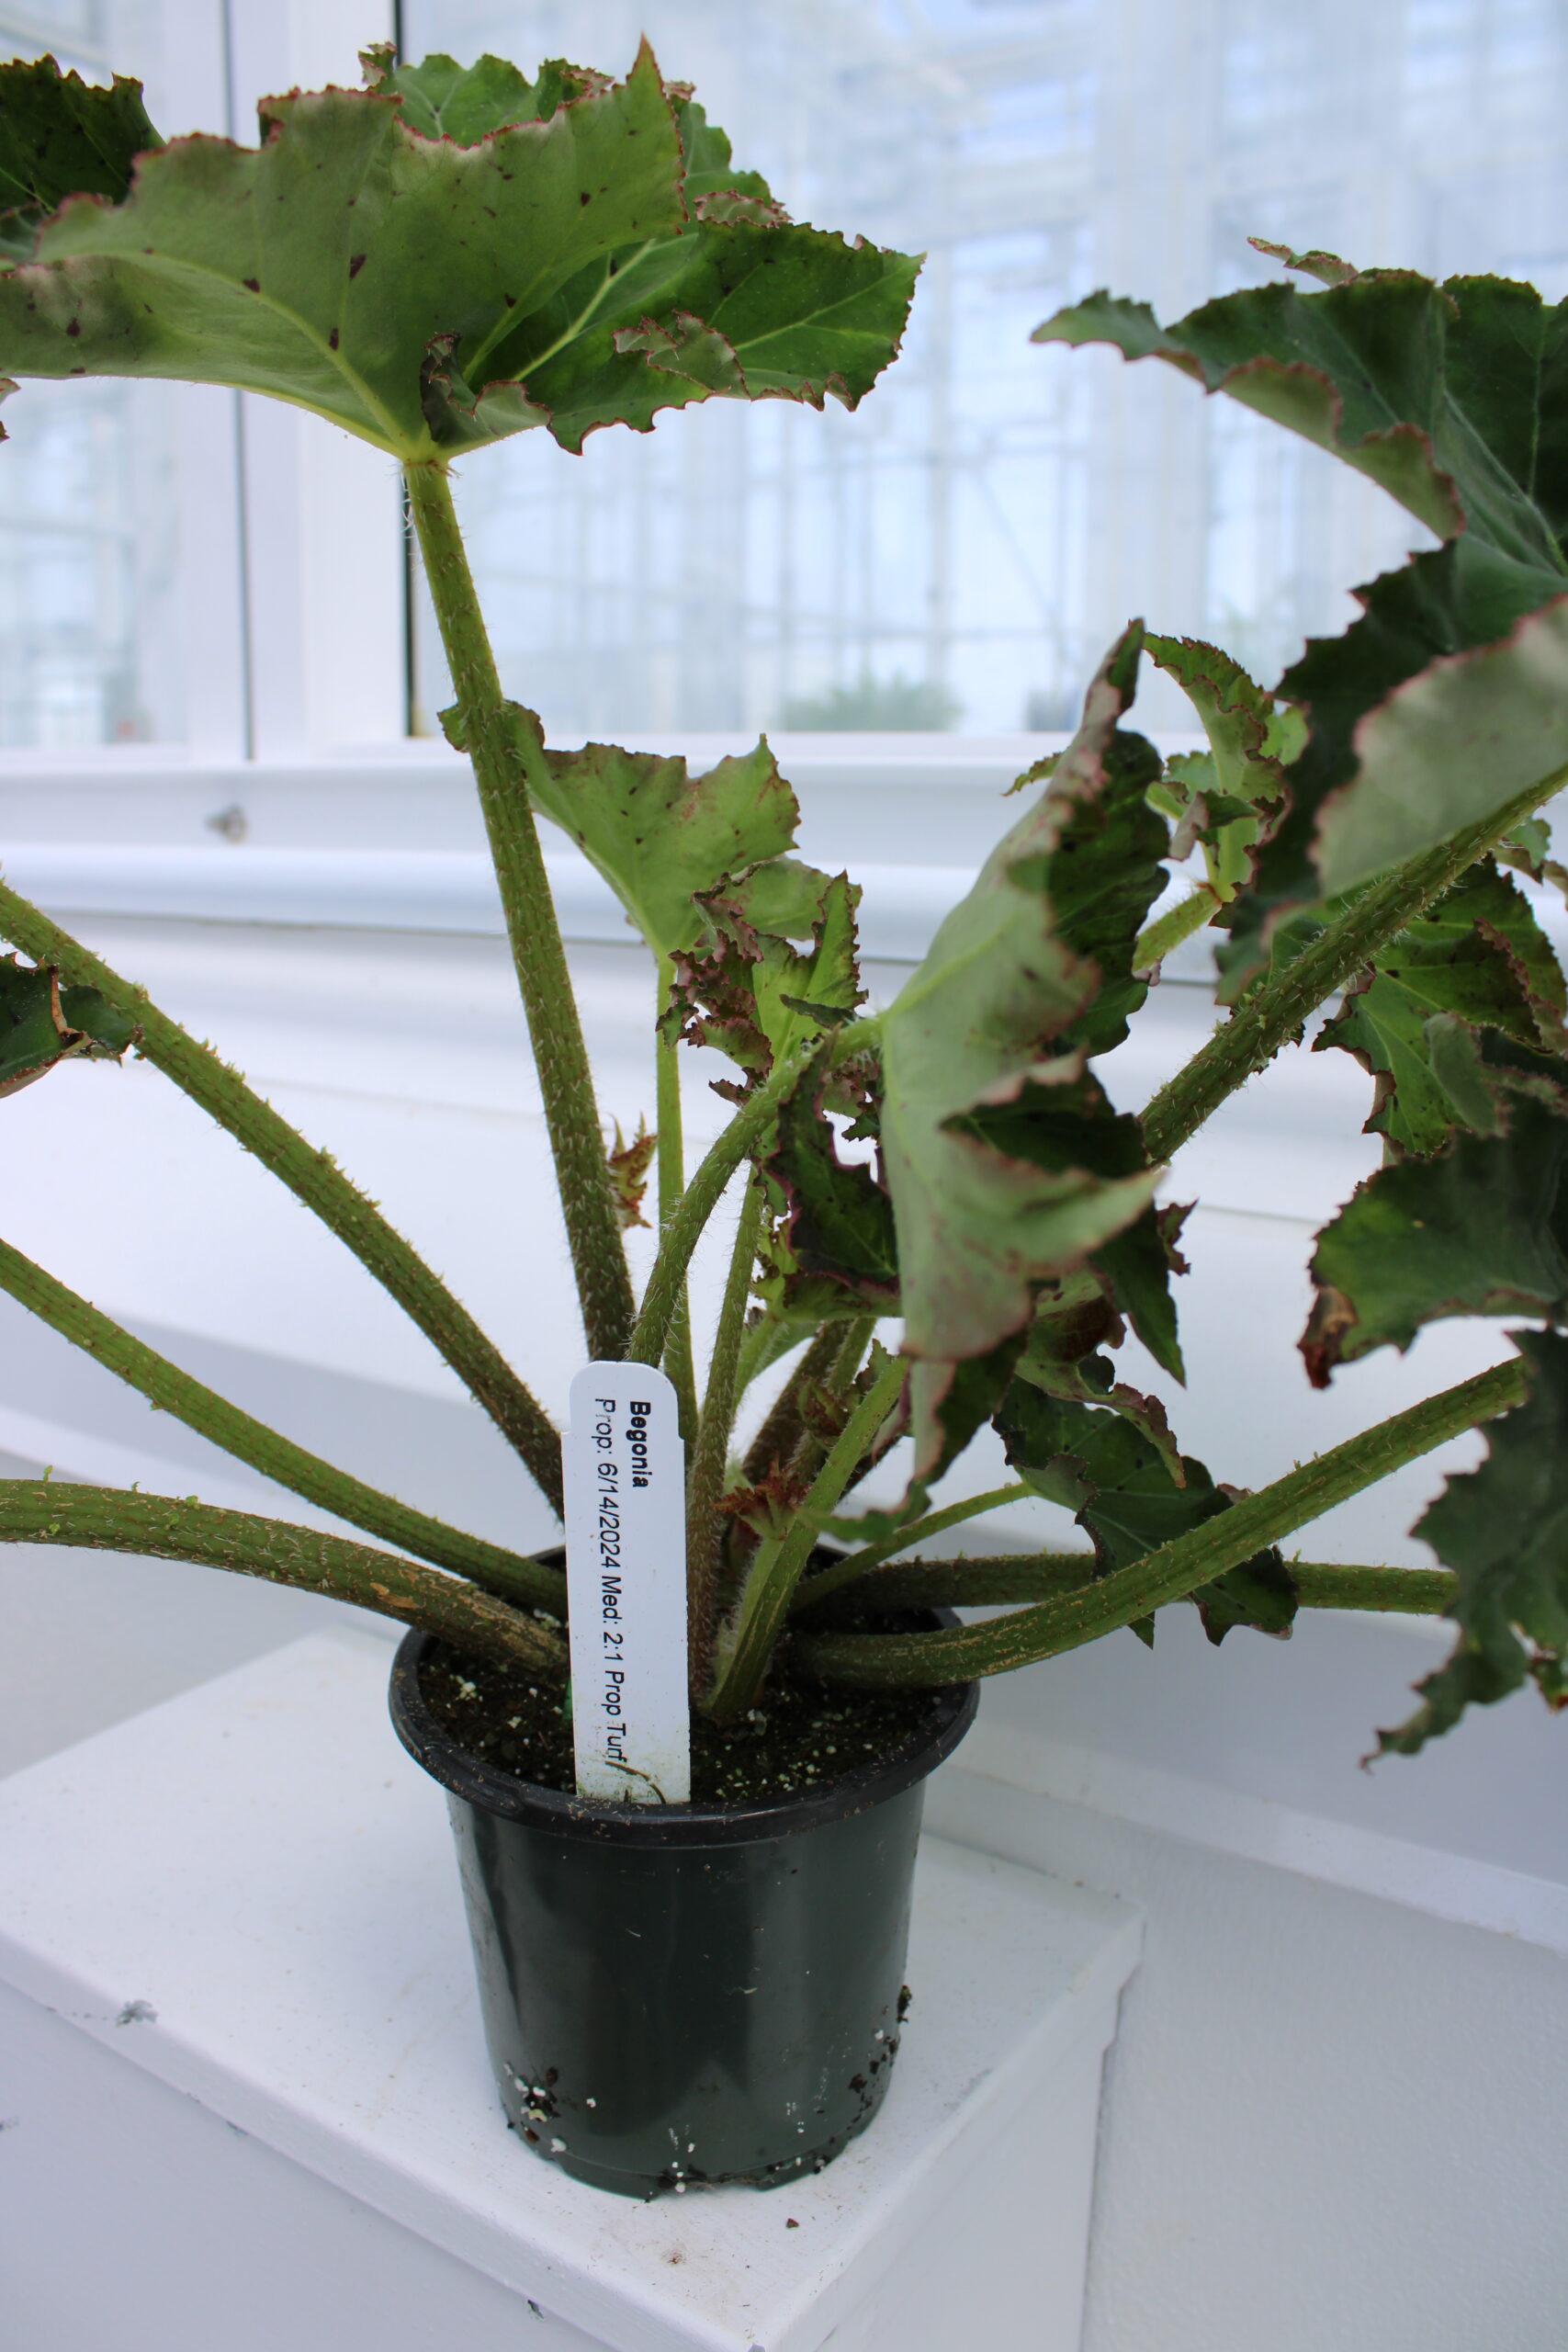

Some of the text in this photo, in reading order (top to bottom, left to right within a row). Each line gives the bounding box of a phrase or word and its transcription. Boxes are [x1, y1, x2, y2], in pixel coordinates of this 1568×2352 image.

[626, 1400, 652, 1488] Begonia
[591, 1398, 627, 1763] Prop: 6/14/2024 Med: 2:1 Prop Turf
